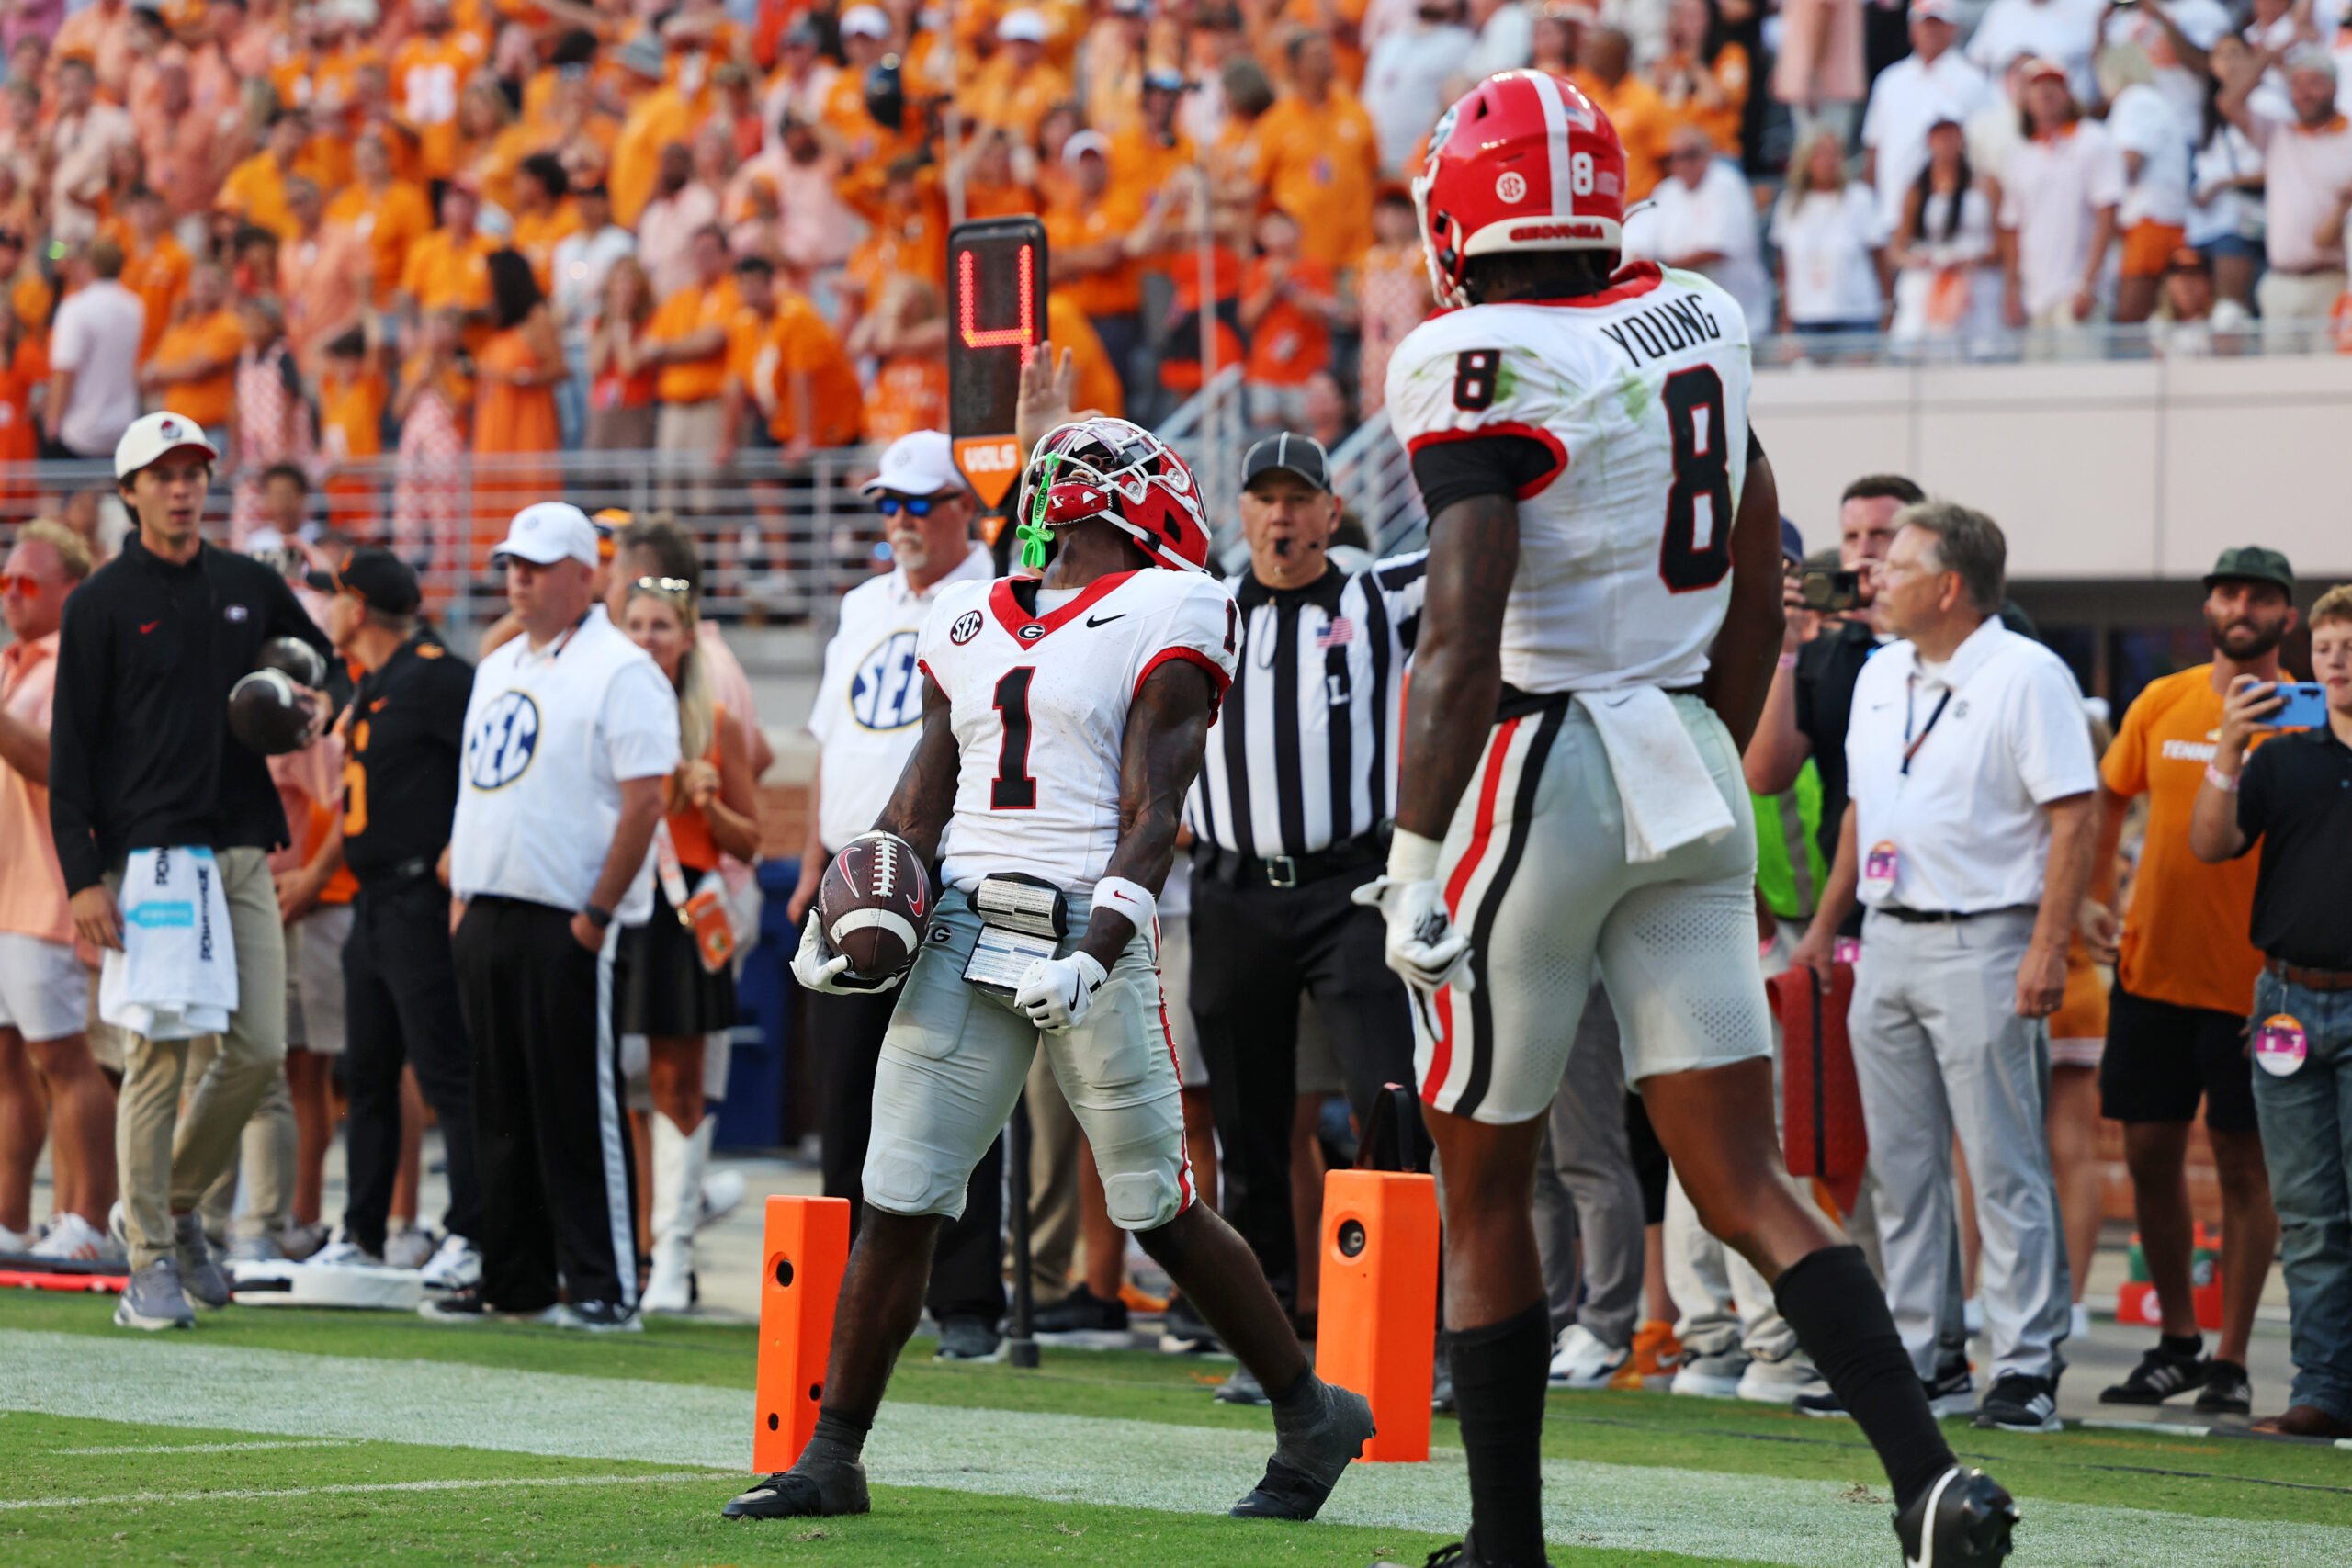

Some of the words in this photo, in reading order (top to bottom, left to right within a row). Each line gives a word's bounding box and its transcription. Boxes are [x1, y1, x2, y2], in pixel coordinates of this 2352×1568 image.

[1571, 152, 1594, 196] 8
[1510, 224, 1604, 242] GEORGIA
[959, 244, 1033, 367] 4
[1600, 294, 1721, 367] YOUNG
[1453, 349, 1501, 412] 8
[964, 445, 1017, 472] VOLS
[1659, 362, 1735, 595] 8
[952, 611, 982, 644] SEC
[1019, 625, 1046, 640] G
[1223, 598, 1238, 656] 1
[1327, 674, 1350, 705] L
[469, 691, 538, 790] SEC
[991, 666, 1036, 810] 1
[931, 925, 952, 942] G
